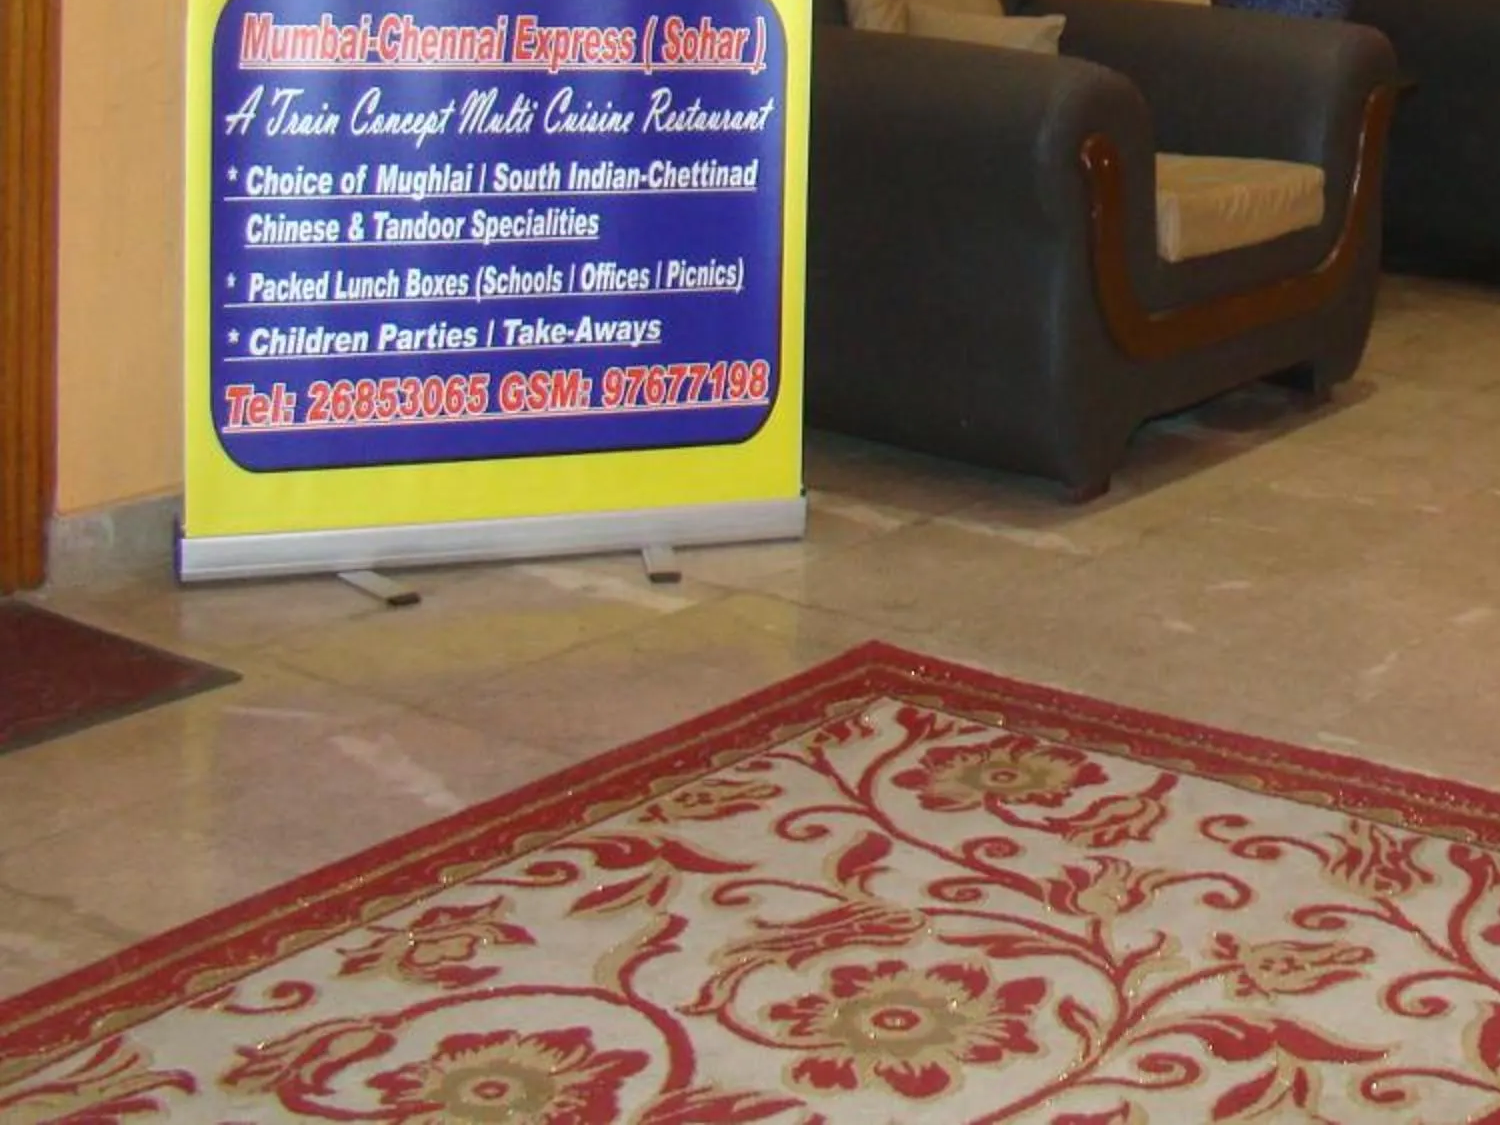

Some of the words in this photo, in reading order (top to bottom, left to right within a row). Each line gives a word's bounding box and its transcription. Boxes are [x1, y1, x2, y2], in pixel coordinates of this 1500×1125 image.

[241, 12, 508, 63] Mumbai-Chennai
[512, 14, 637, 74] Express
[224, 84, 264, 135] A
[267, 87, 340, 136] Train
[352, 86, 456, 149] Concept
[458, 87, 538, 135] Multi
[544, 86, 634, 135] Cuisine
[643, 87, 775, 134] Restaurant
[246, 164, 333, 196] Choice
[341, 163, 367, 194] of
[376, 162, 473, 200] Mughlai
[493, 161, 561, 192] South
[568, 158, 759, 190] Indian-Chettinad
[246, 213, 340, 243] Chinese
[348, 212, 365, 241] &
[373, 211, 466, 240] Tandoor
[471, 207, 599, 246] Specialities
[248, 271, 330, 302] Packed
[334, 269, 399, 300] Lunch
[405, 268, 469, 298] Boxes
[475, 264, 562, 302] (Schools
[581, 262, 650, 291] Offices
[666, 257, 744, 294] Picnics)
[249, 326, 369, 356] Children
[377, 322, 478, 350] Parties
[503, 315, 662, 347] Take-Aways
[225, 382, 296, 426] Tel:
[307, 372, 490, 423] 26853065
[499, 368, 593, 413] GSM:
[602, 358, 770, 408] 97677198
